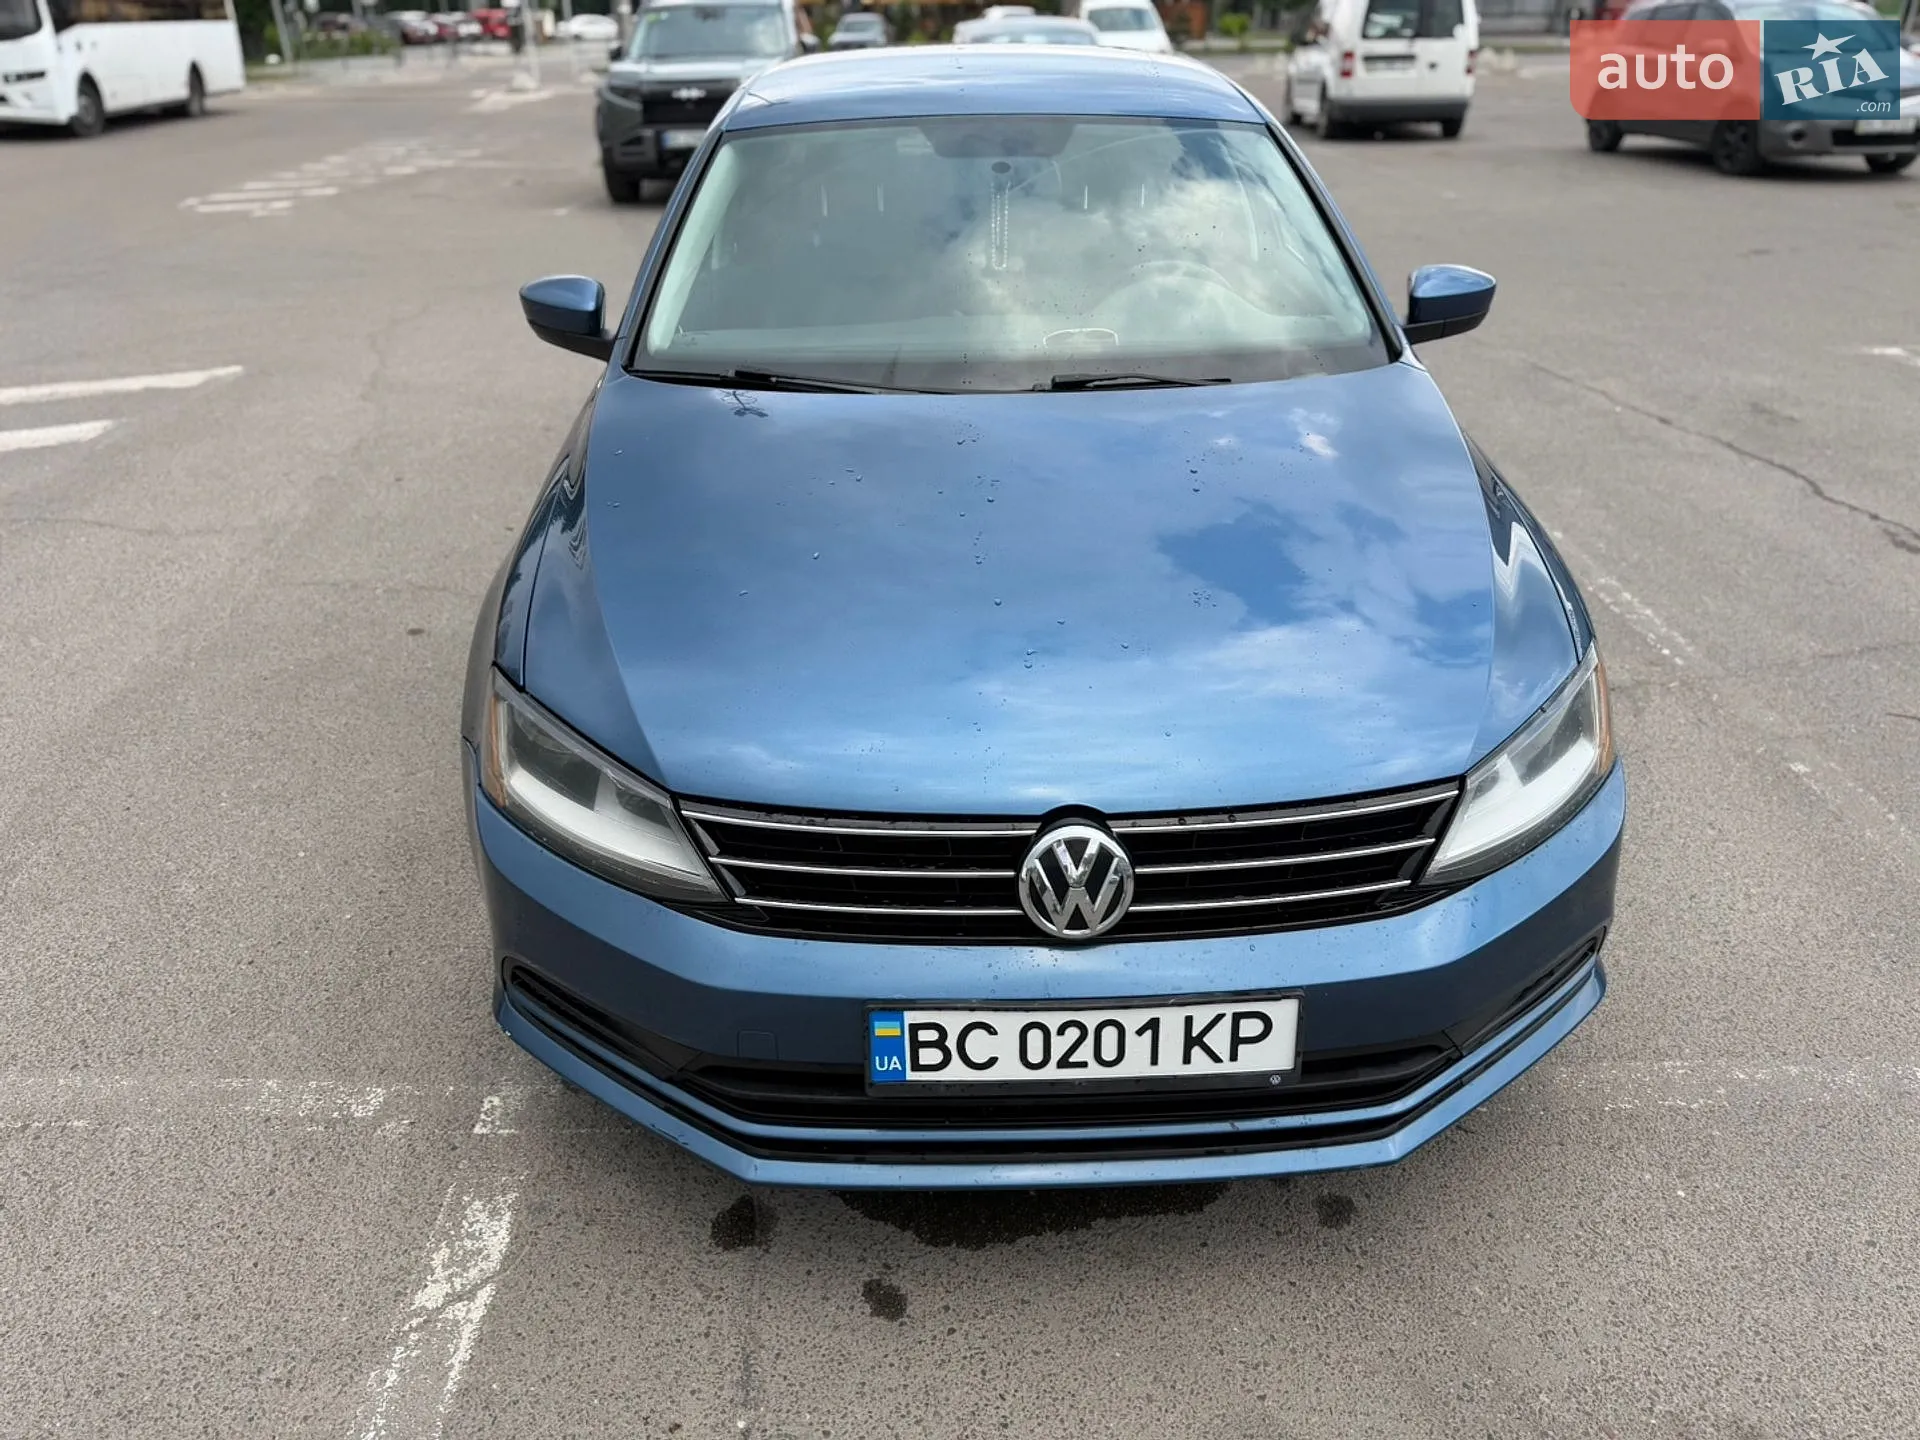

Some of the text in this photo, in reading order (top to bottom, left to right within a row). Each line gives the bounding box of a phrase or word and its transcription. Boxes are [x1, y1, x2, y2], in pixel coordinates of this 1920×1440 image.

[908, 1011, 1273, 1072] BC 0201 KP
[875, 1055, 902, 1071] UA
